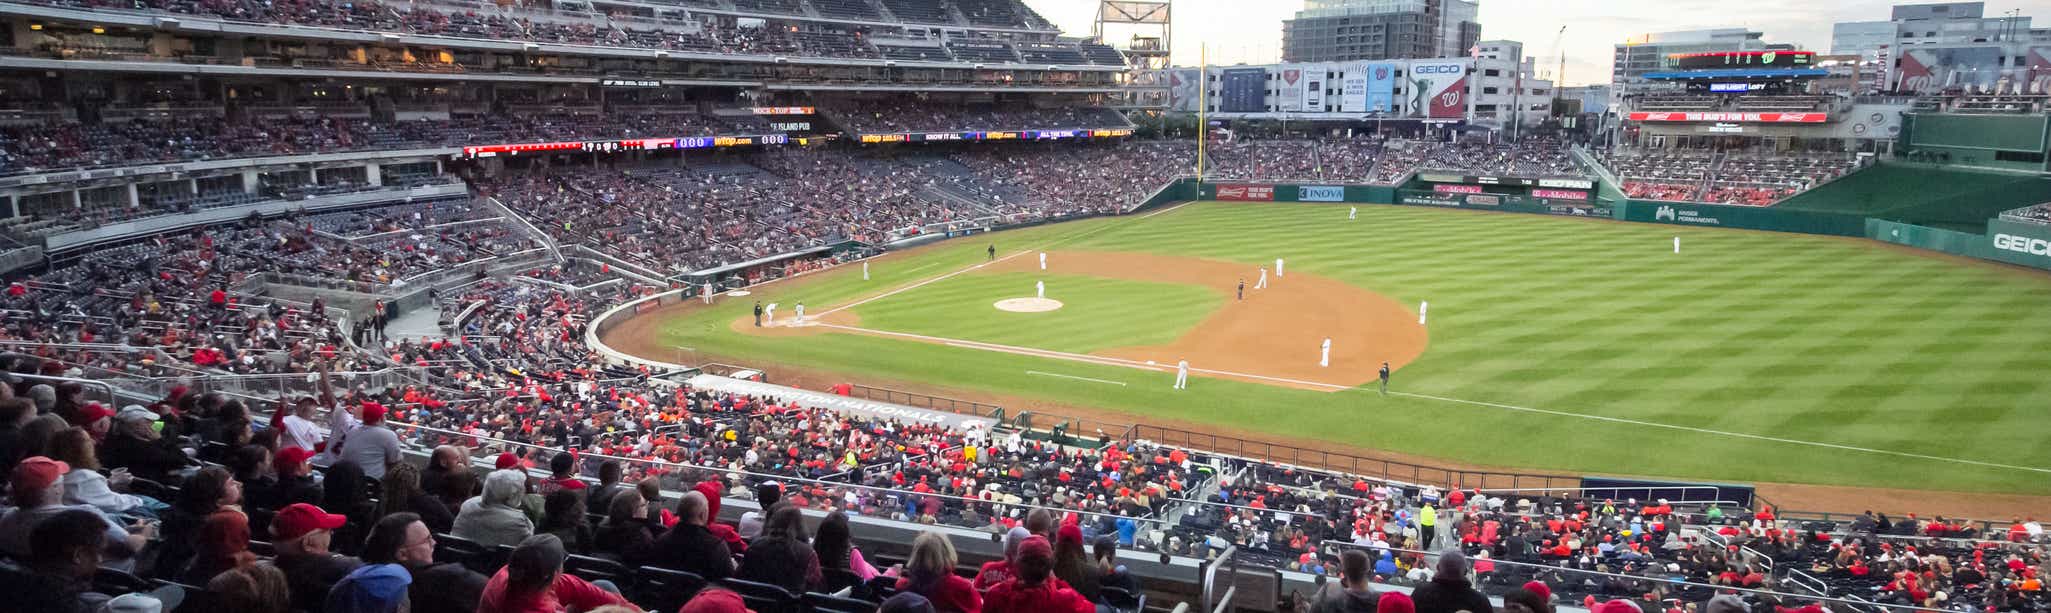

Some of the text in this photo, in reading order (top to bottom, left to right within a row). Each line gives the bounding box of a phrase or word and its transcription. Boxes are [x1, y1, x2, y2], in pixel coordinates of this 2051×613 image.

[1416, 65, 1460, 74] GEICO
[778, 122, 798, 131] ISLAND
[799, 122, 810, 130] PUB
[1310, 190, 1343, 199] INOVA
[1993, 233, 2051, 257] GEIC
[838, 400, 946, 422] NATIONALS
